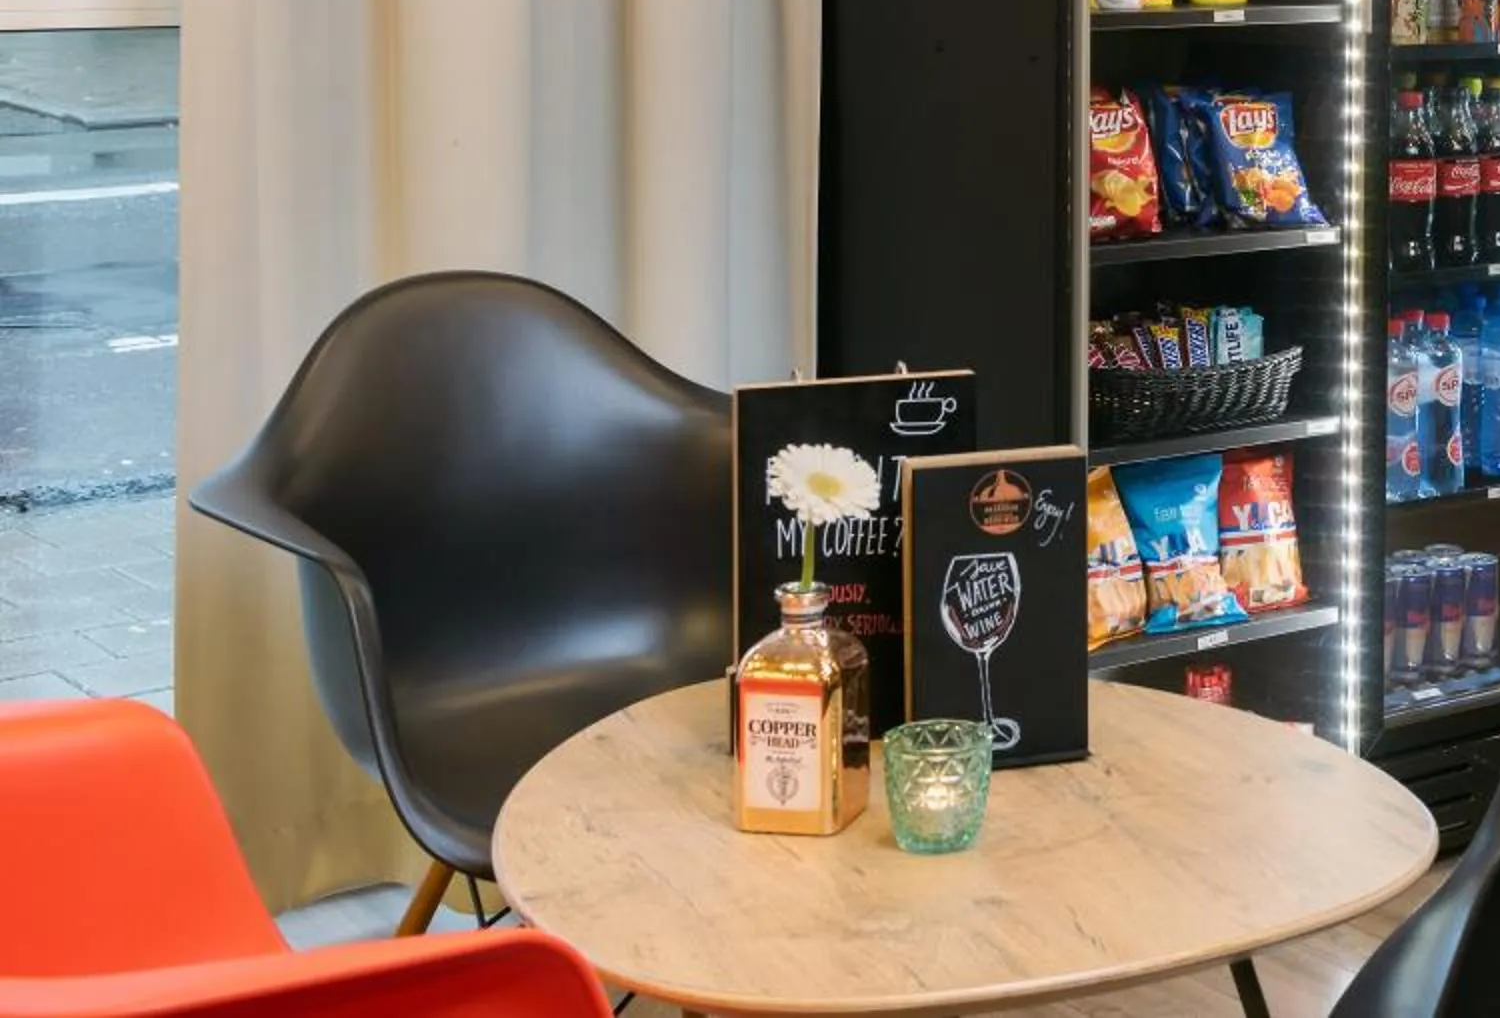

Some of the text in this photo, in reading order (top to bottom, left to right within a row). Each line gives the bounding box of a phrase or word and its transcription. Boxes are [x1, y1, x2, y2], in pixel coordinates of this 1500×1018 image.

[776, 517, 808, 559] MY
[946, 572, 1014, 612] WATER
[963, 610, 1003, 640] WINE
[748, 719, 817, 737] COPPER
[766, 735, 800, 750] HEAD
